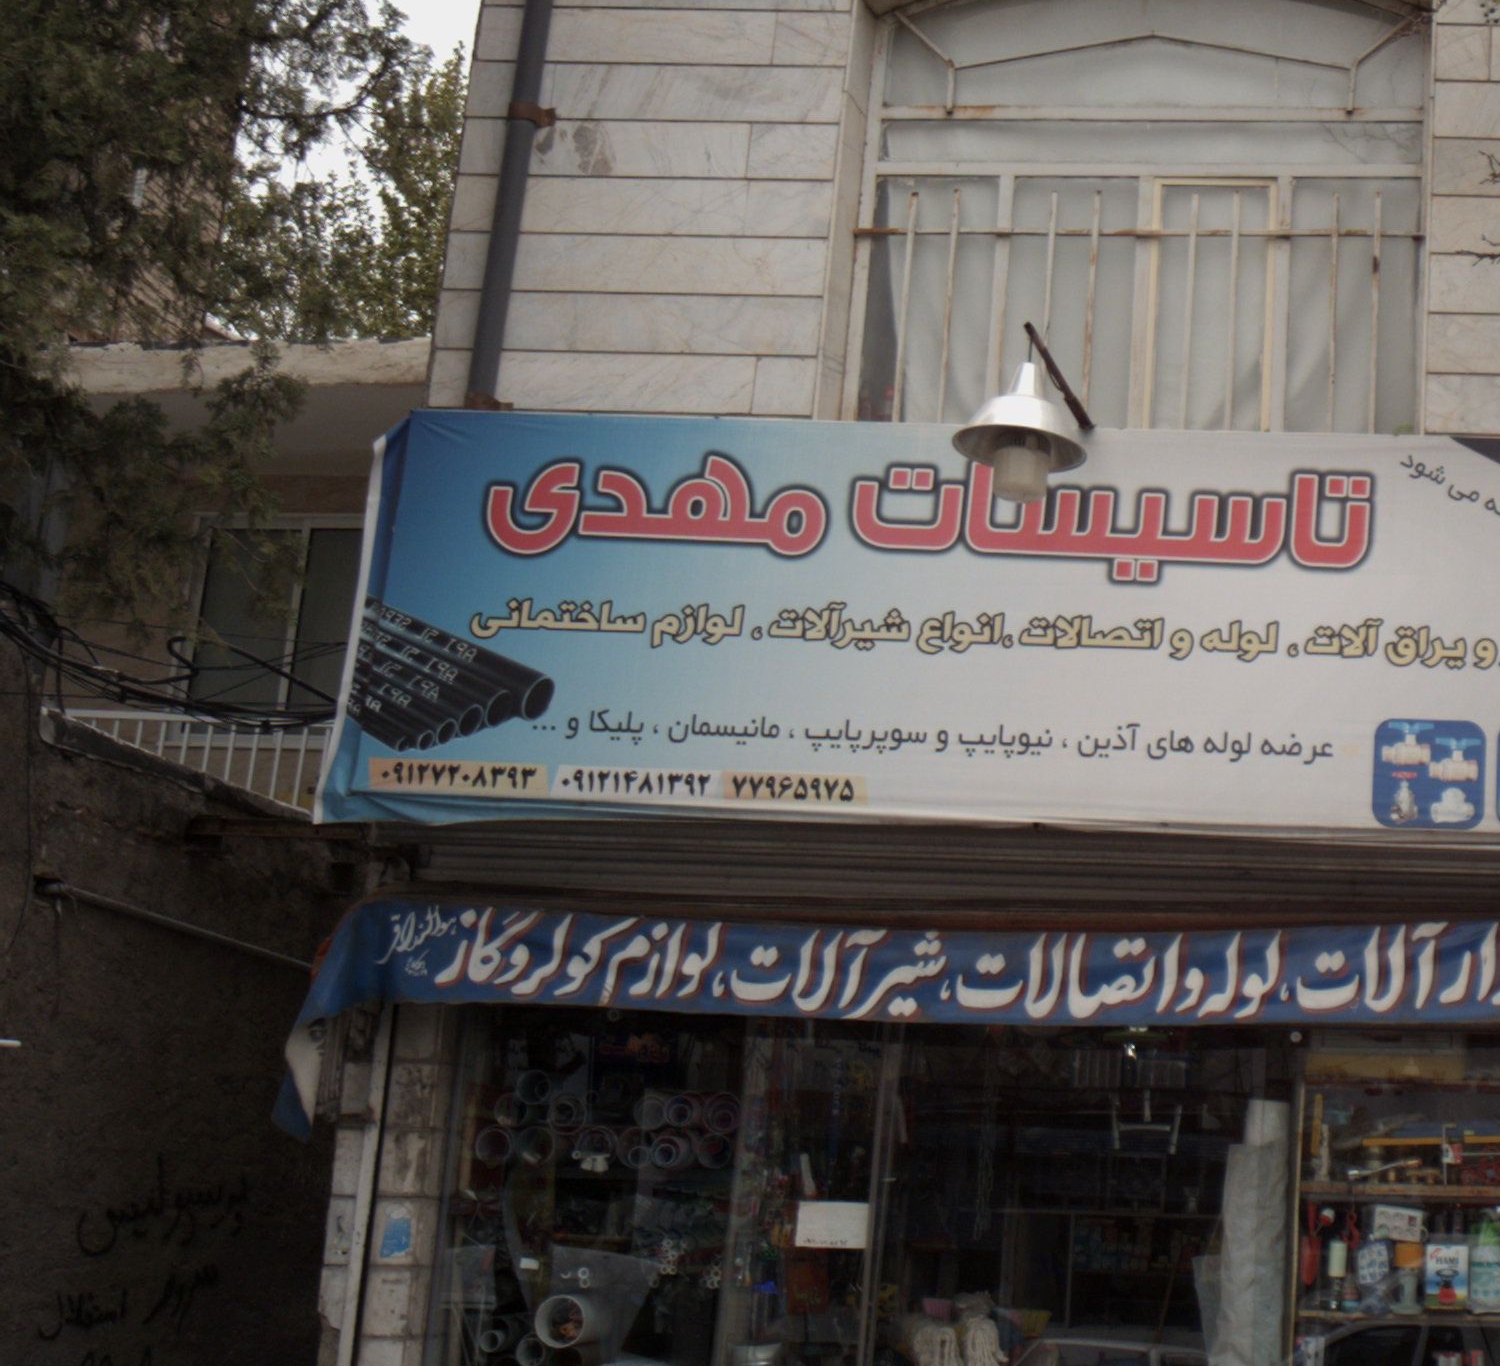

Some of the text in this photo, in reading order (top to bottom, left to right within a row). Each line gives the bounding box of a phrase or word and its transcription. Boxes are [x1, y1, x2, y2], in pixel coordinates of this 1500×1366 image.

[1400, 455, 1446, 485] شود
[1447, 484, 1480, 502] می
[485, 453, 1377, 583] تاسیسات مهدی
[470, 598, 646, 639] ساختمانی
[651, 604, 745, 648] لوازم
[1172, 629, 1191, 659] و
[1201, 621, 1278, 661] لوله
[1384, 627, 1466, 670] یراق
[1474, 641, 1497, 669] و
[565, 716, 579, 739] و
[587, 710, 645, 740] پلیکا
[935, 729, 949, 752] و
[958, 725, 1054, 759] نیوپایپ
[1147, 729, 1194, 761] های
[1203, 732, 1254, 763] لوله
[1259, 733, 1334, 764] عرضه
[733, 776, 854, 802] ۷۷۹۶۵۹۷۵
[434, 906, 545, 985] گاز
[510, 914, 642, 998] کولر
[602, 922, 722, 1004] لوازم
[1199, 930, 1281, 1019] لوله
[1174, 967, 1203, 1014] و
